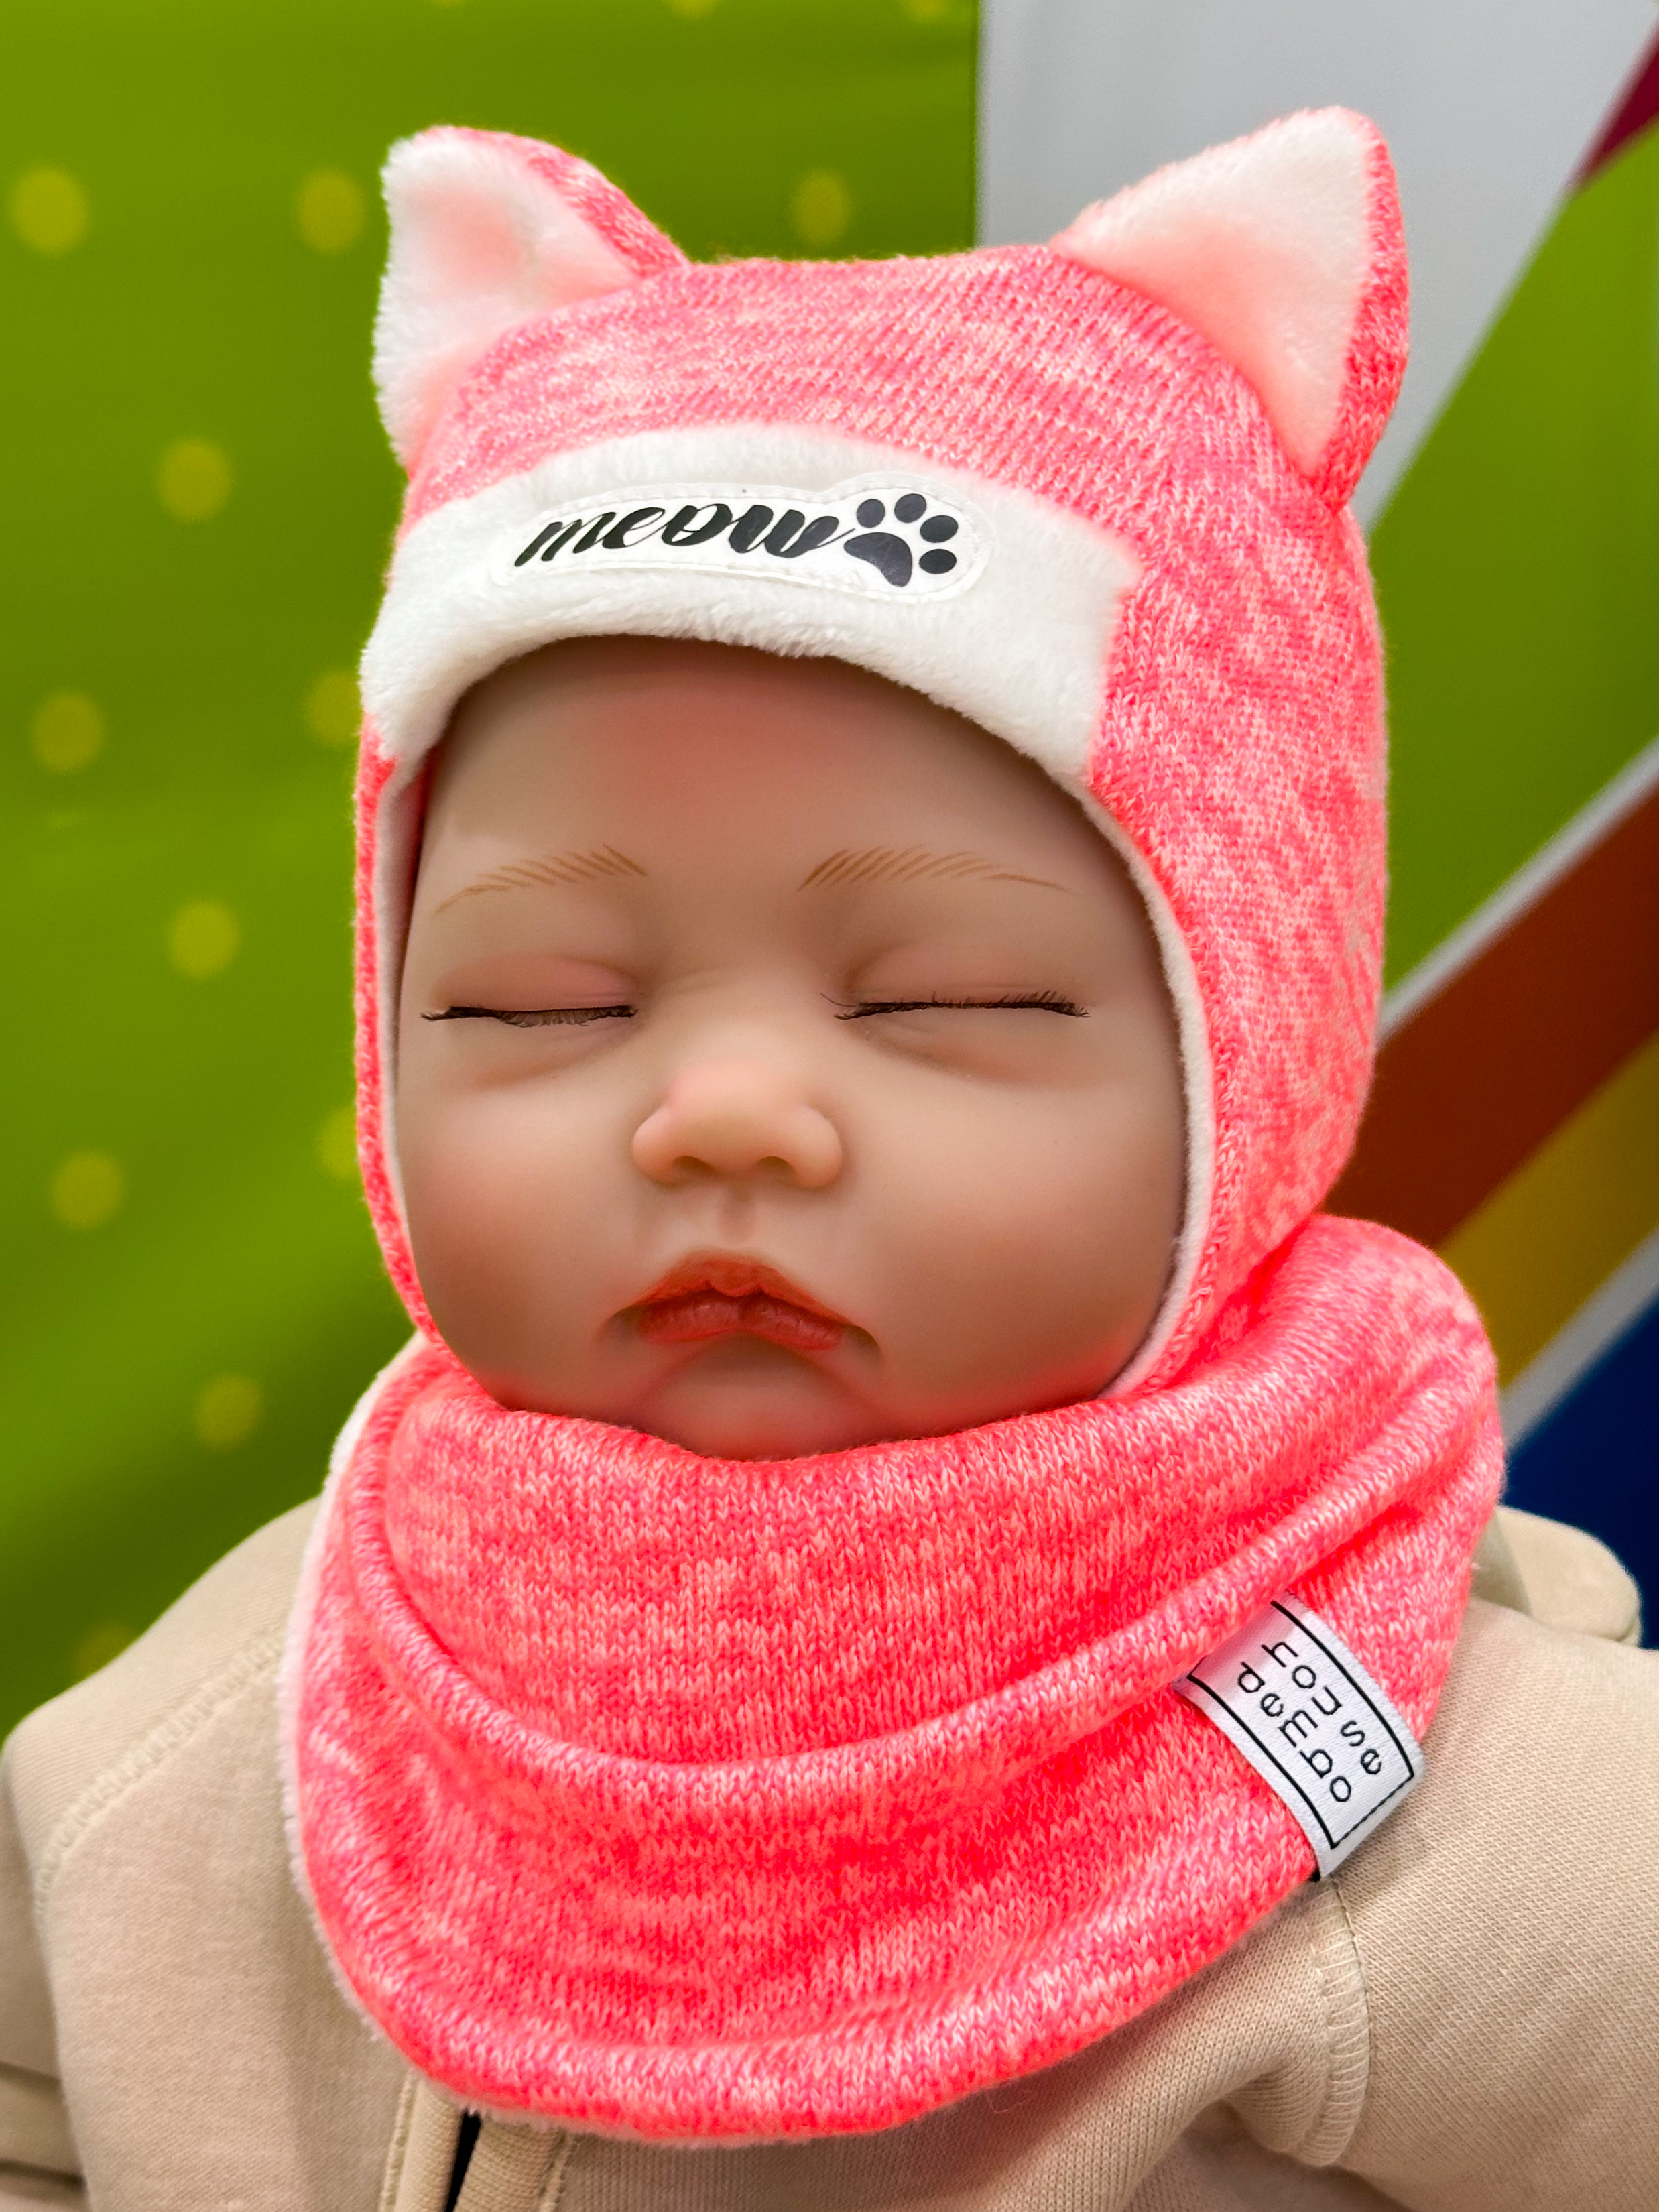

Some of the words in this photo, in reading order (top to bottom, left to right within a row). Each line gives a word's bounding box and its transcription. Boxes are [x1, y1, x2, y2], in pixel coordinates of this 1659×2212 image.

[514, 503, 856, 567] meow
[1237, 1661, 1352, 1802] dembo
[1261, 1641, 1382, 1775] house
